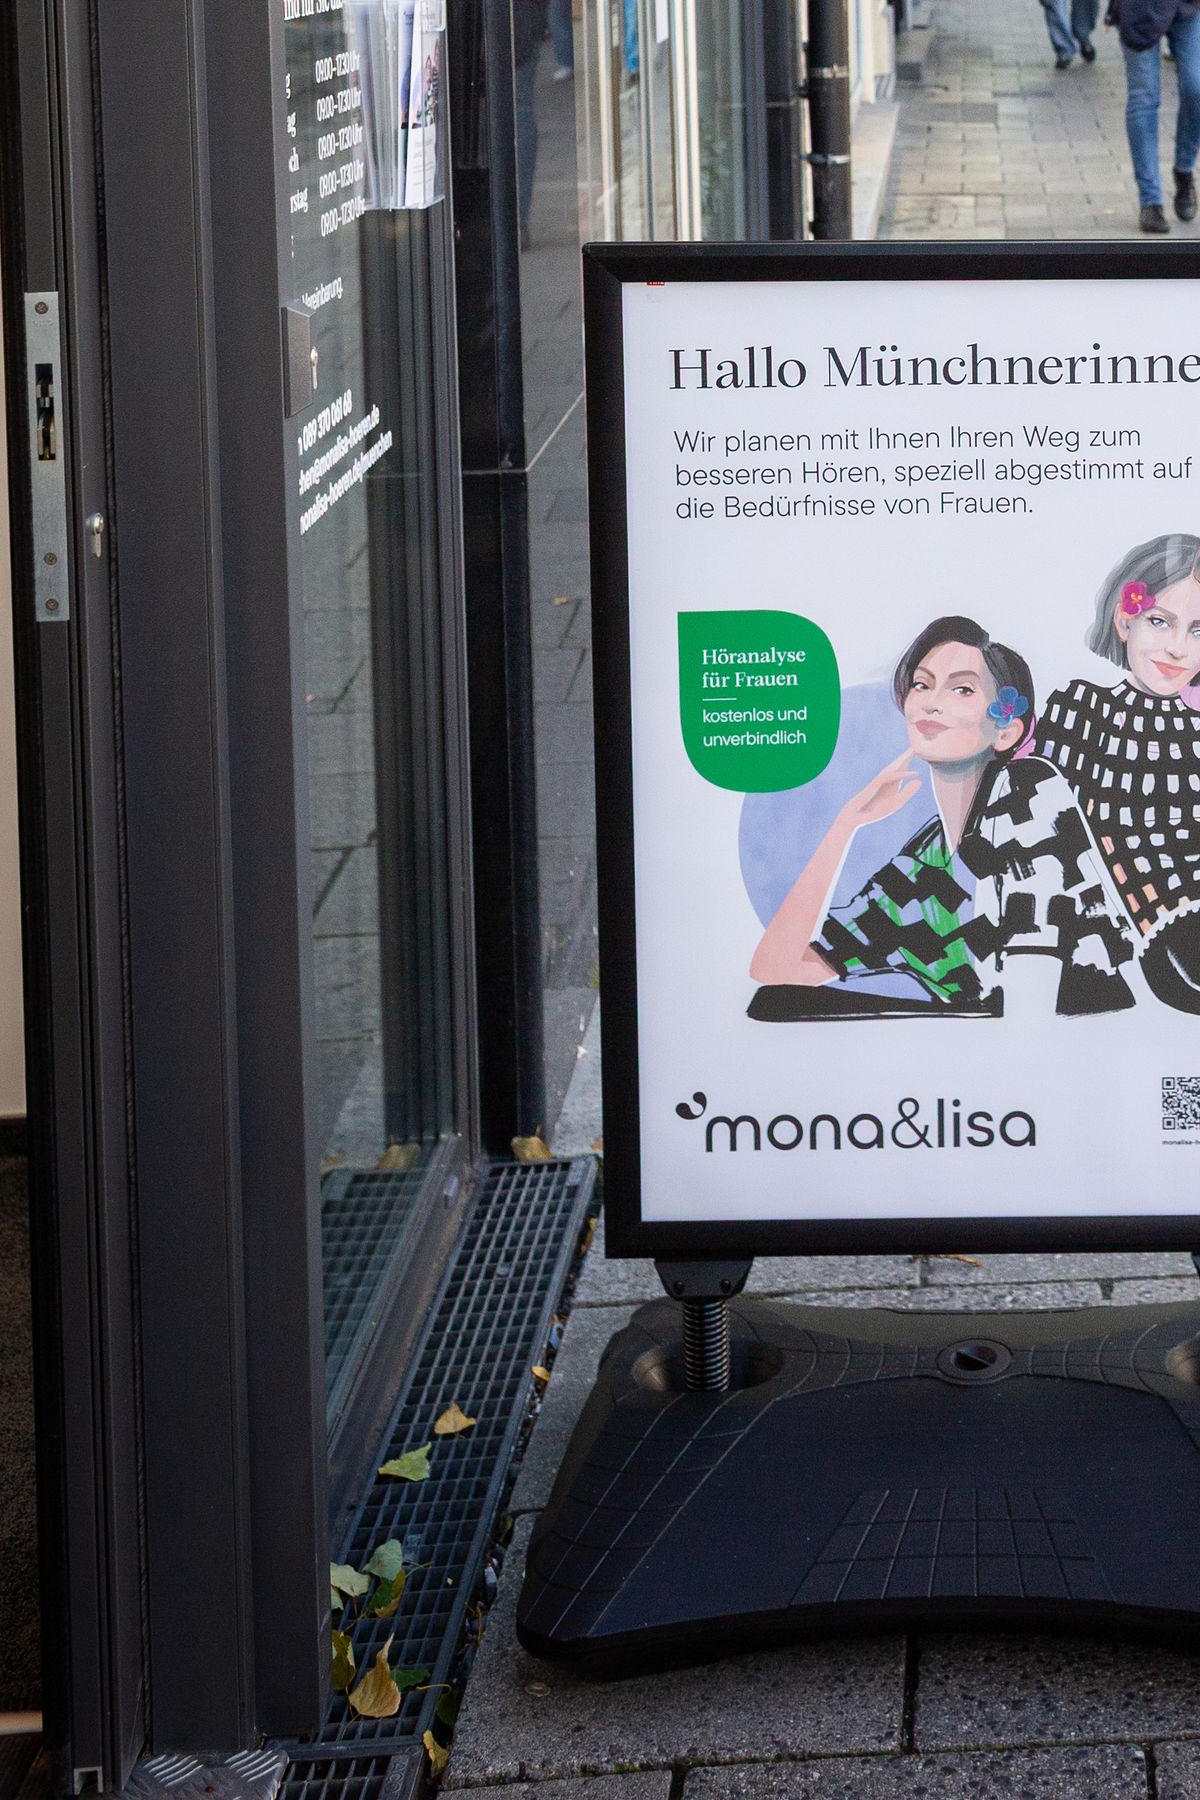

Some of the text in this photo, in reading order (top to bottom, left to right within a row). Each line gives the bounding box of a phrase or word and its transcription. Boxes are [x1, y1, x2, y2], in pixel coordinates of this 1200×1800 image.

[350, 50, 360, 72] Uhr
[351, 86, 362, 109] Uhr
[352, 122, 363, 146] Uhr
[354, 159, 364, 182] Uhr
[355, 195, 365, 218] Uhr
[668, 346, 807, 390] Hallo
[318, 407, 331, 438] 370
[299, 404, 380, 496] hen@monalisa-hoeren.de
[674, 425, 1141, 457] Wir planen mit Ihnen Ihren Weg zum
[675, 457, 1193, 487] besseren Hören, speziell abgestimmt auf
[675, 492, 1033, 520] die Bedürfnisse von Frauen.
[702, 647, 806, 667] Höranalyse
[702, 671, 798, 689] für Frauen
[702, 706, 807, 723] kostenlos und
[703, 730, 807, 747] unverbindlich
[705, 1097, 1037, 1153] mona&lisa
